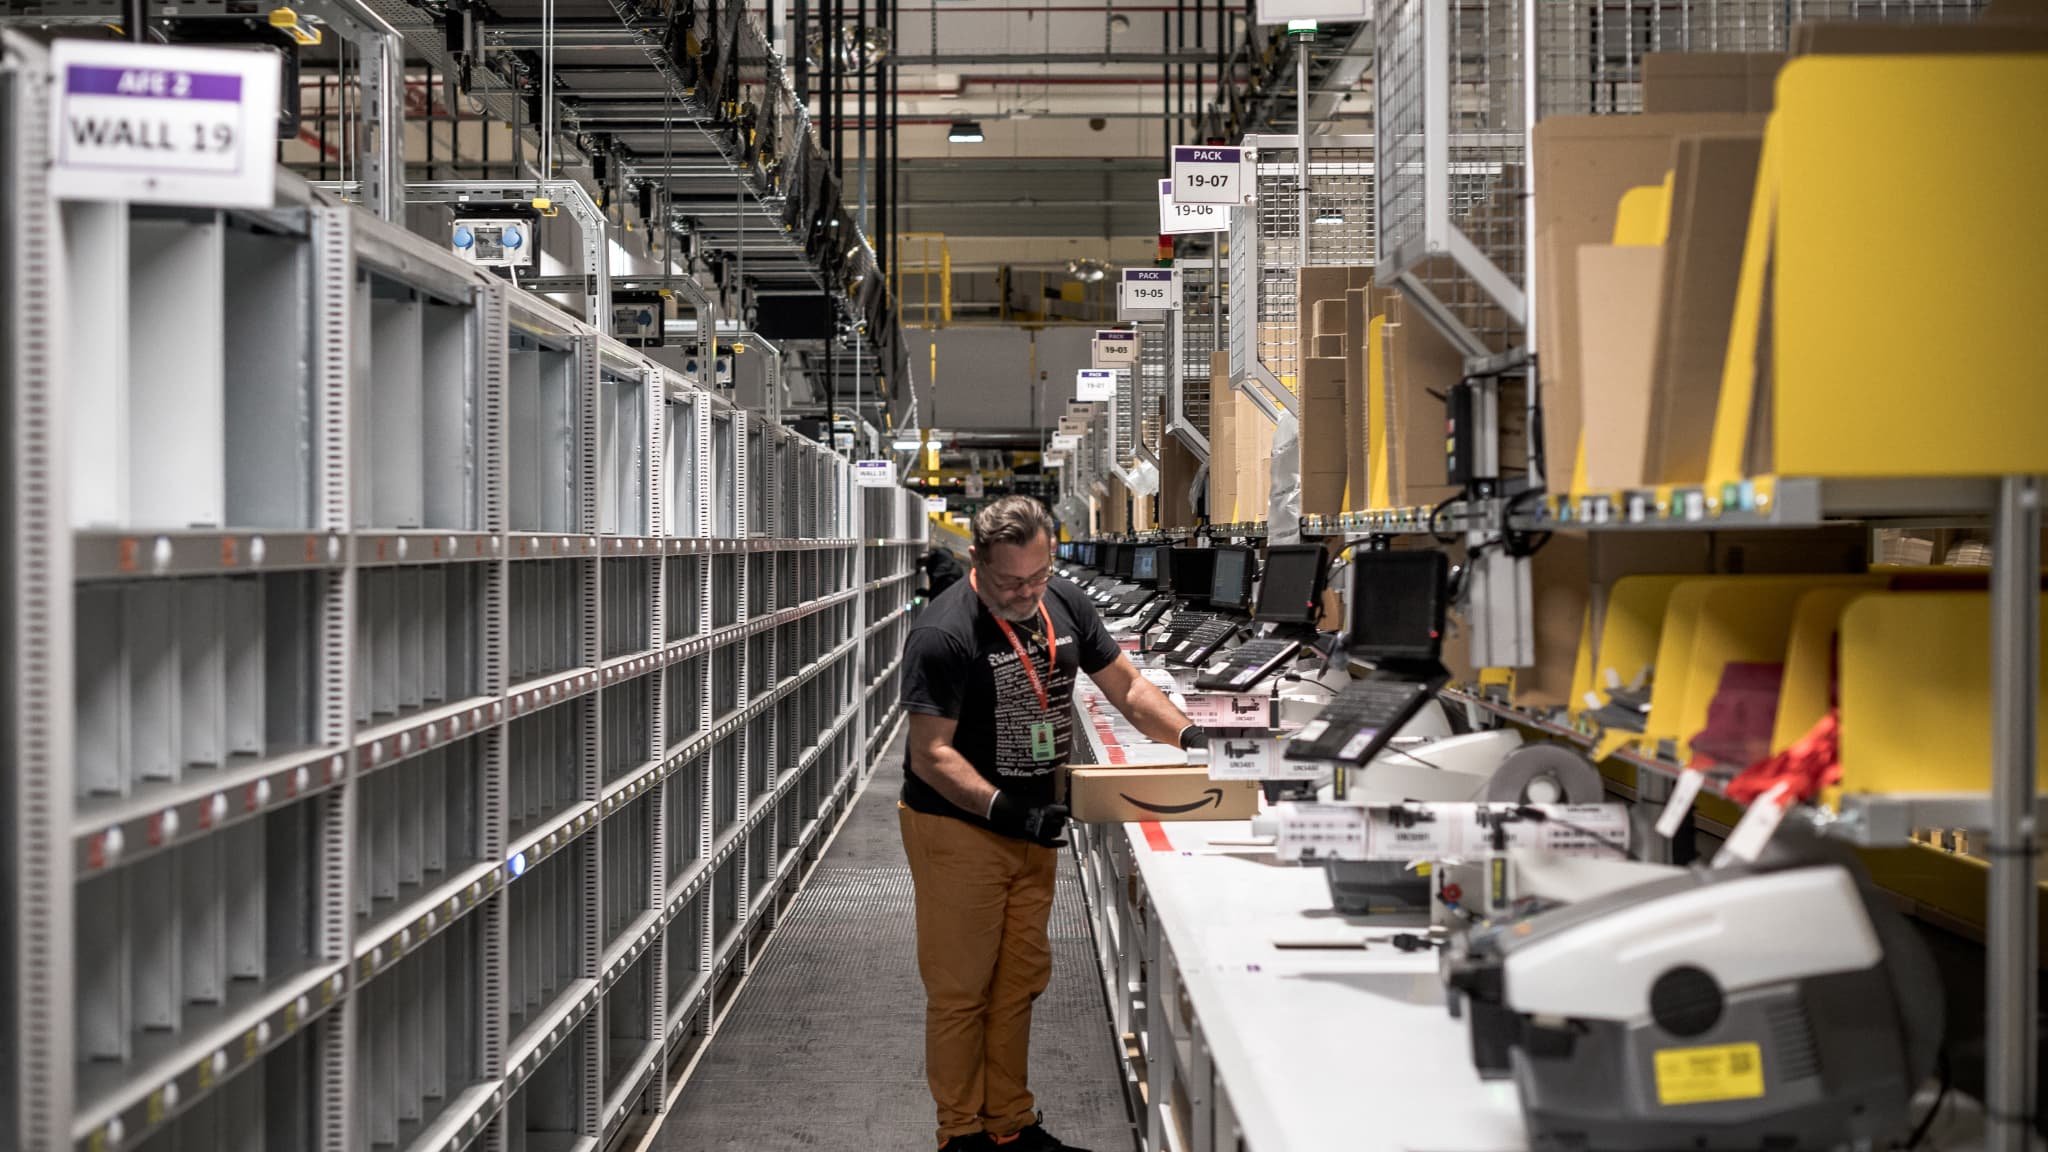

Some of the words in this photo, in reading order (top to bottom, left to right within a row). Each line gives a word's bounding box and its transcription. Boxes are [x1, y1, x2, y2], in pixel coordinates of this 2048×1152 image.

[117, 69, 166, 96] AFE
[172, 71, 192, 98] 2
[69, 117, 176, 150] WALL
[193, 122, 234, 154] 19
[1193, 150, 1222, 160] PACK
[1187, 174, 1229, 188] 19-07
[1175, 204, 1214, 216] 19-06
[1138, 272, 1160, 280] PACK
[1134, 289, 1164, 298] 19-05
[1105, 346, 1128, 354] 19-03
[1230, 761, 1255, 769] UN3481
